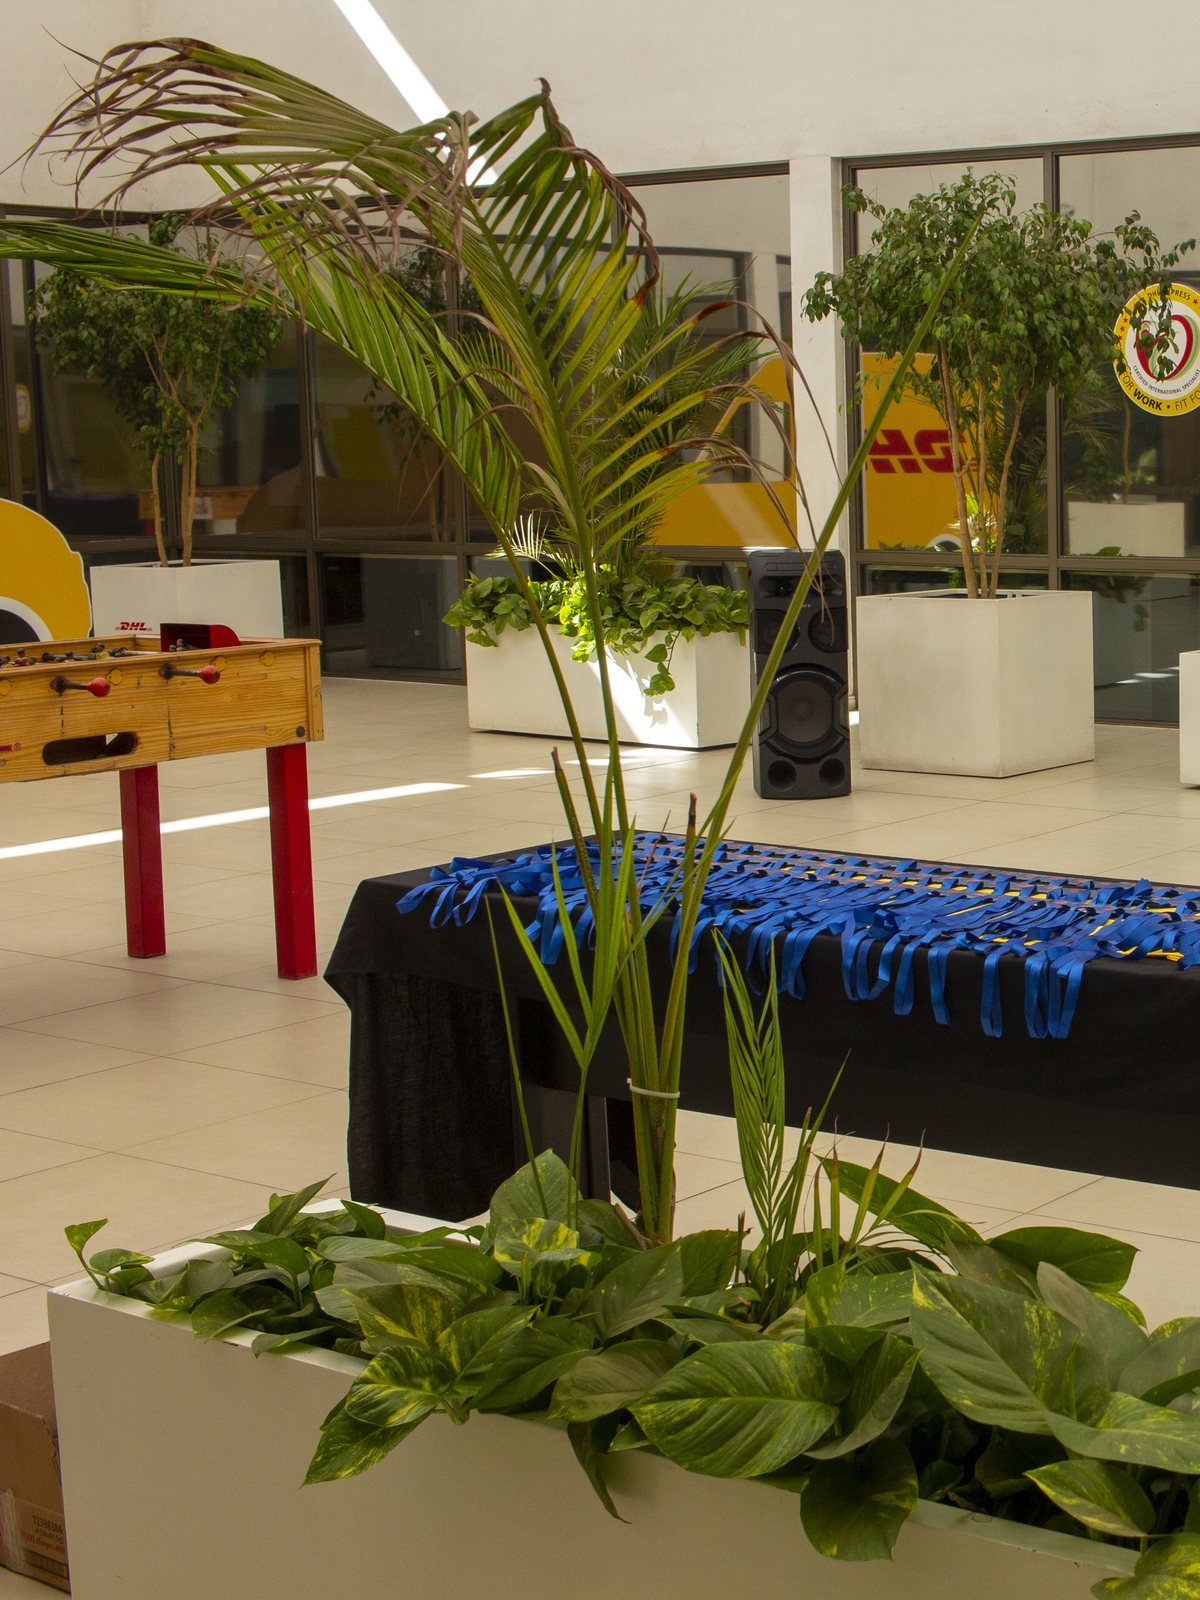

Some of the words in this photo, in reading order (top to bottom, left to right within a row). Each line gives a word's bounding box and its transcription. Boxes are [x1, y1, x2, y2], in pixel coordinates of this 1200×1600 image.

[1148, 384, 1182, 395] INTERNATIONAL
[1182, 369, 1200, 391] SPECIALIST
[1133, 388, 1162, 411] WORK
[1174, 399, 1188, 411] FIT
[119, 622, 148, 631] DHL
